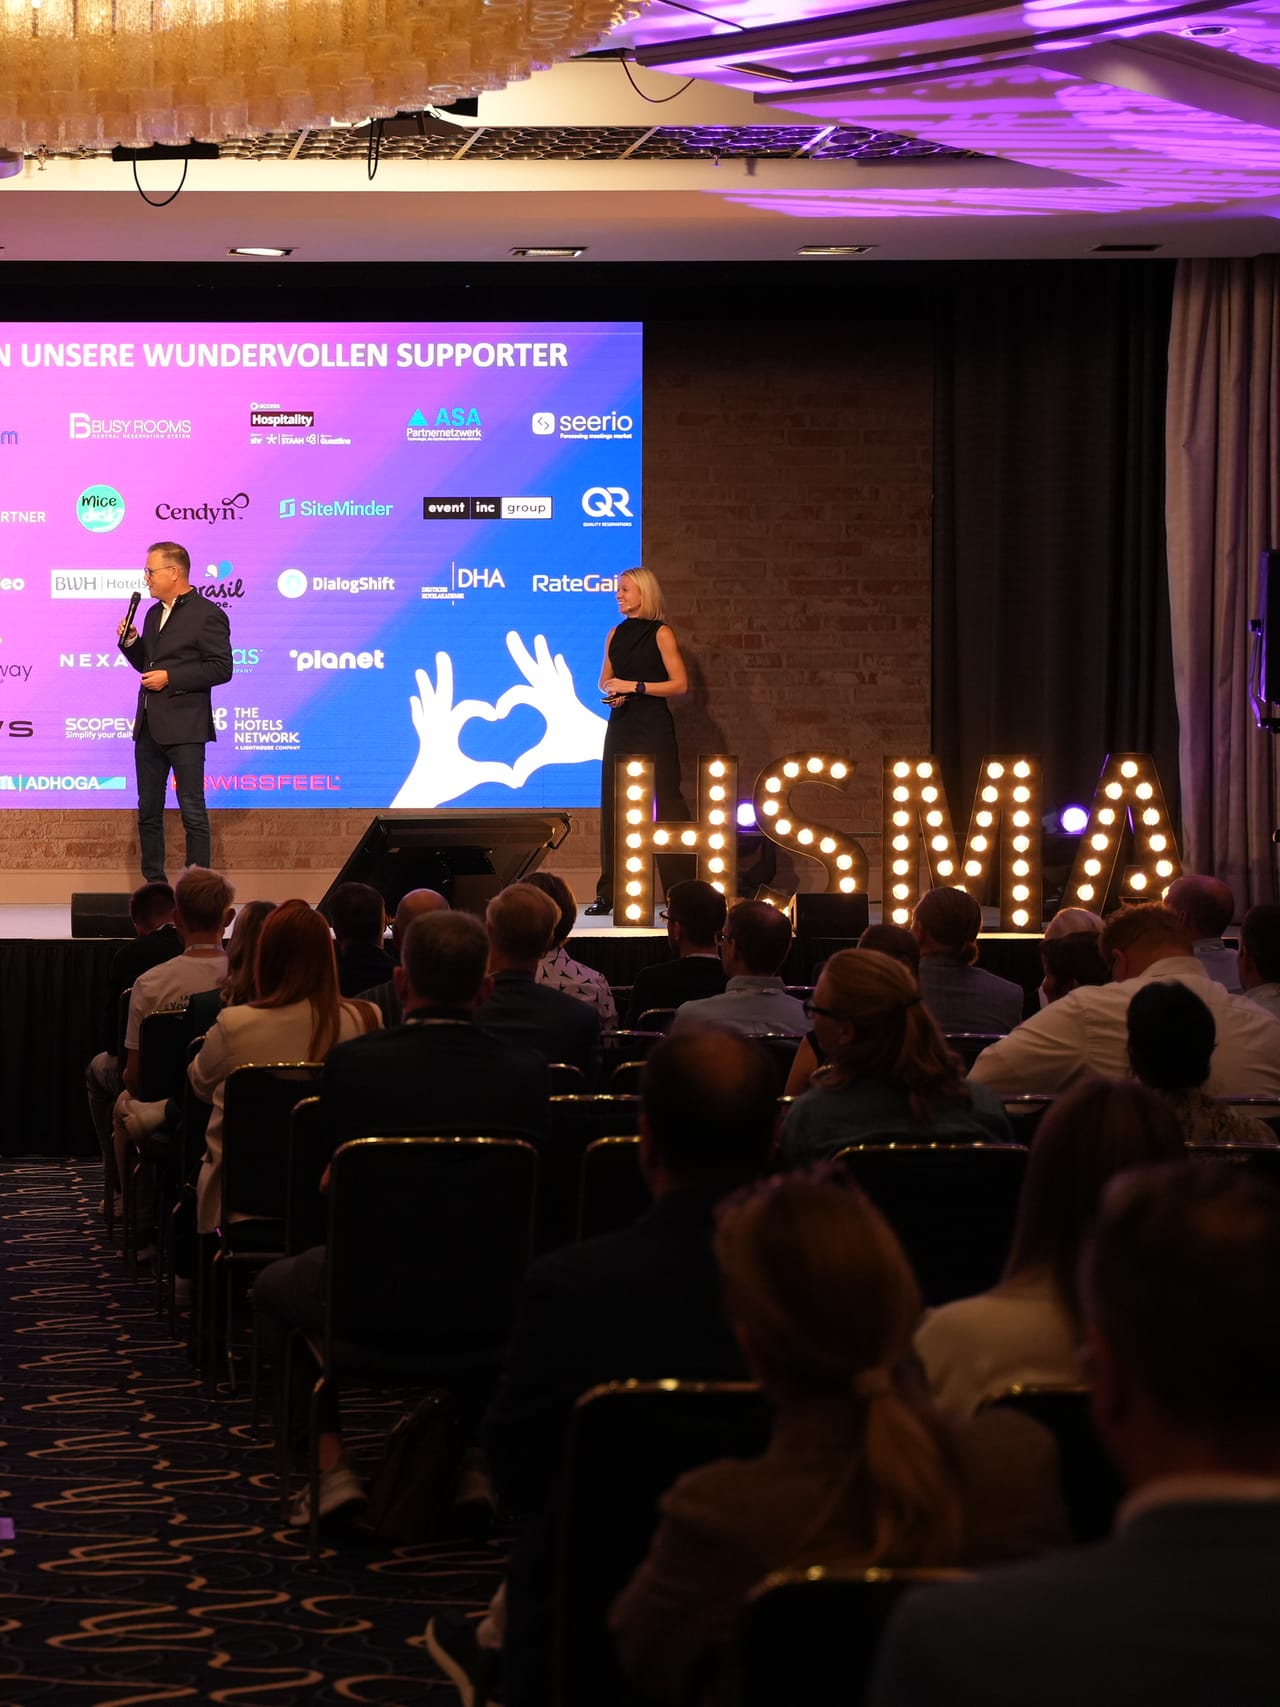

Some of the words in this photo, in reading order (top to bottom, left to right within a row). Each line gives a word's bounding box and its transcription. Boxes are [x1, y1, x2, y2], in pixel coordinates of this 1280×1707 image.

[21, 343, 134, 368] UNSERE
[143, 343, 388, 368] WUNDERVOLLEN
[396, 343, 568, 368] SUPPORTER
[252, 413, 313, 427] Hospitality
[435, 408, 482, 426] ASA
[559, 411, 633, 432] seerio
[91, 420, 131, 433] BUSY
[133, 420, 192, 433] ROOMS
[406, 428, 482, 438] Partnernetzwerk
[300, 500, 394, 517] SiteMinder
[428, 502, 466, 513] event
[476, 501, 496, 513] inc
[507, 504, 547, 515] group
[581, 486, 635, 518] QR
[155, 503, 236, 525] Cendyn
[55, 577, 97, 591] BWH
[312, 576, 395, 593] DialogShift
[458, 568, 506, 588] DHA
[532, 574, 619, 593] RateGai
[59, 653, 129, 668] NEXA
[296, 649, 385, 671] planet
[234, 706, 259, 718] THE
[65, 717, 136, 731] SCOPEV
[234, 719, 283, 731] HOTELS
[65, 730, 97, 740] Simplify
[98, 732, 116, 740] your
[234, 731, 301, 744] NETWORK
[25, 776, 101, 791] ADHOGA
[204, 774, 340, 791] WISSFEEL
[612, 751, 1185, 932] HSMA
